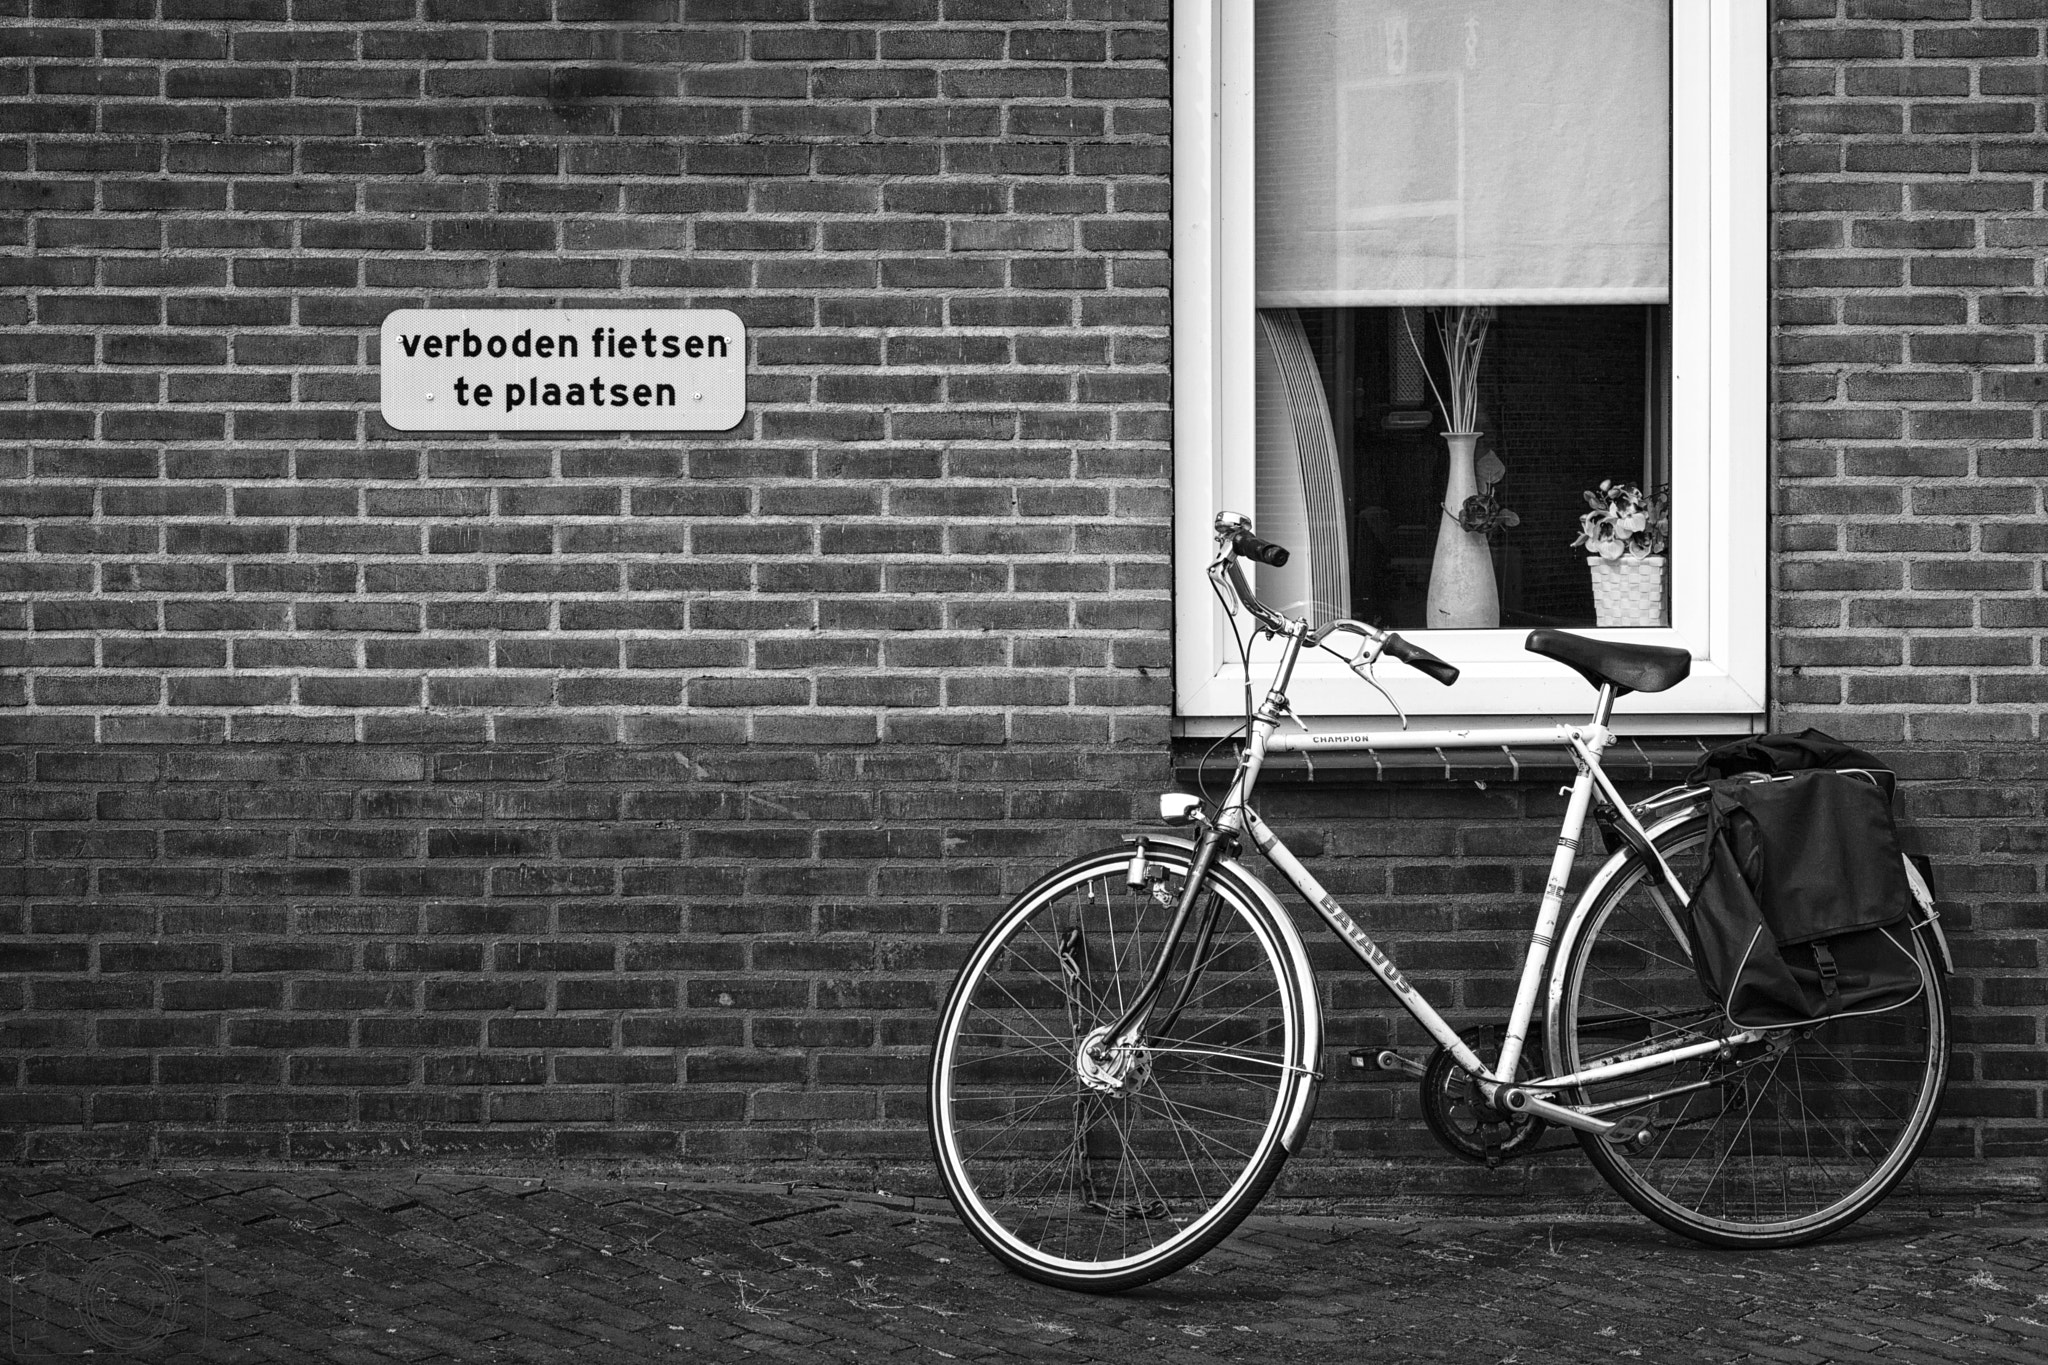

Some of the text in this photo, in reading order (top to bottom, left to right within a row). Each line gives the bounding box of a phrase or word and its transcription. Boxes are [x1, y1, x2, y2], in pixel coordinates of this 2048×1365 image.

[401, 328, 726, 358] verboden fietsen
[454, 377, 675, 412] te plaatsen
[1312, 735, 1369, 744] CHAMPION
[1320, 893, 1413, 994] BATAVUS
